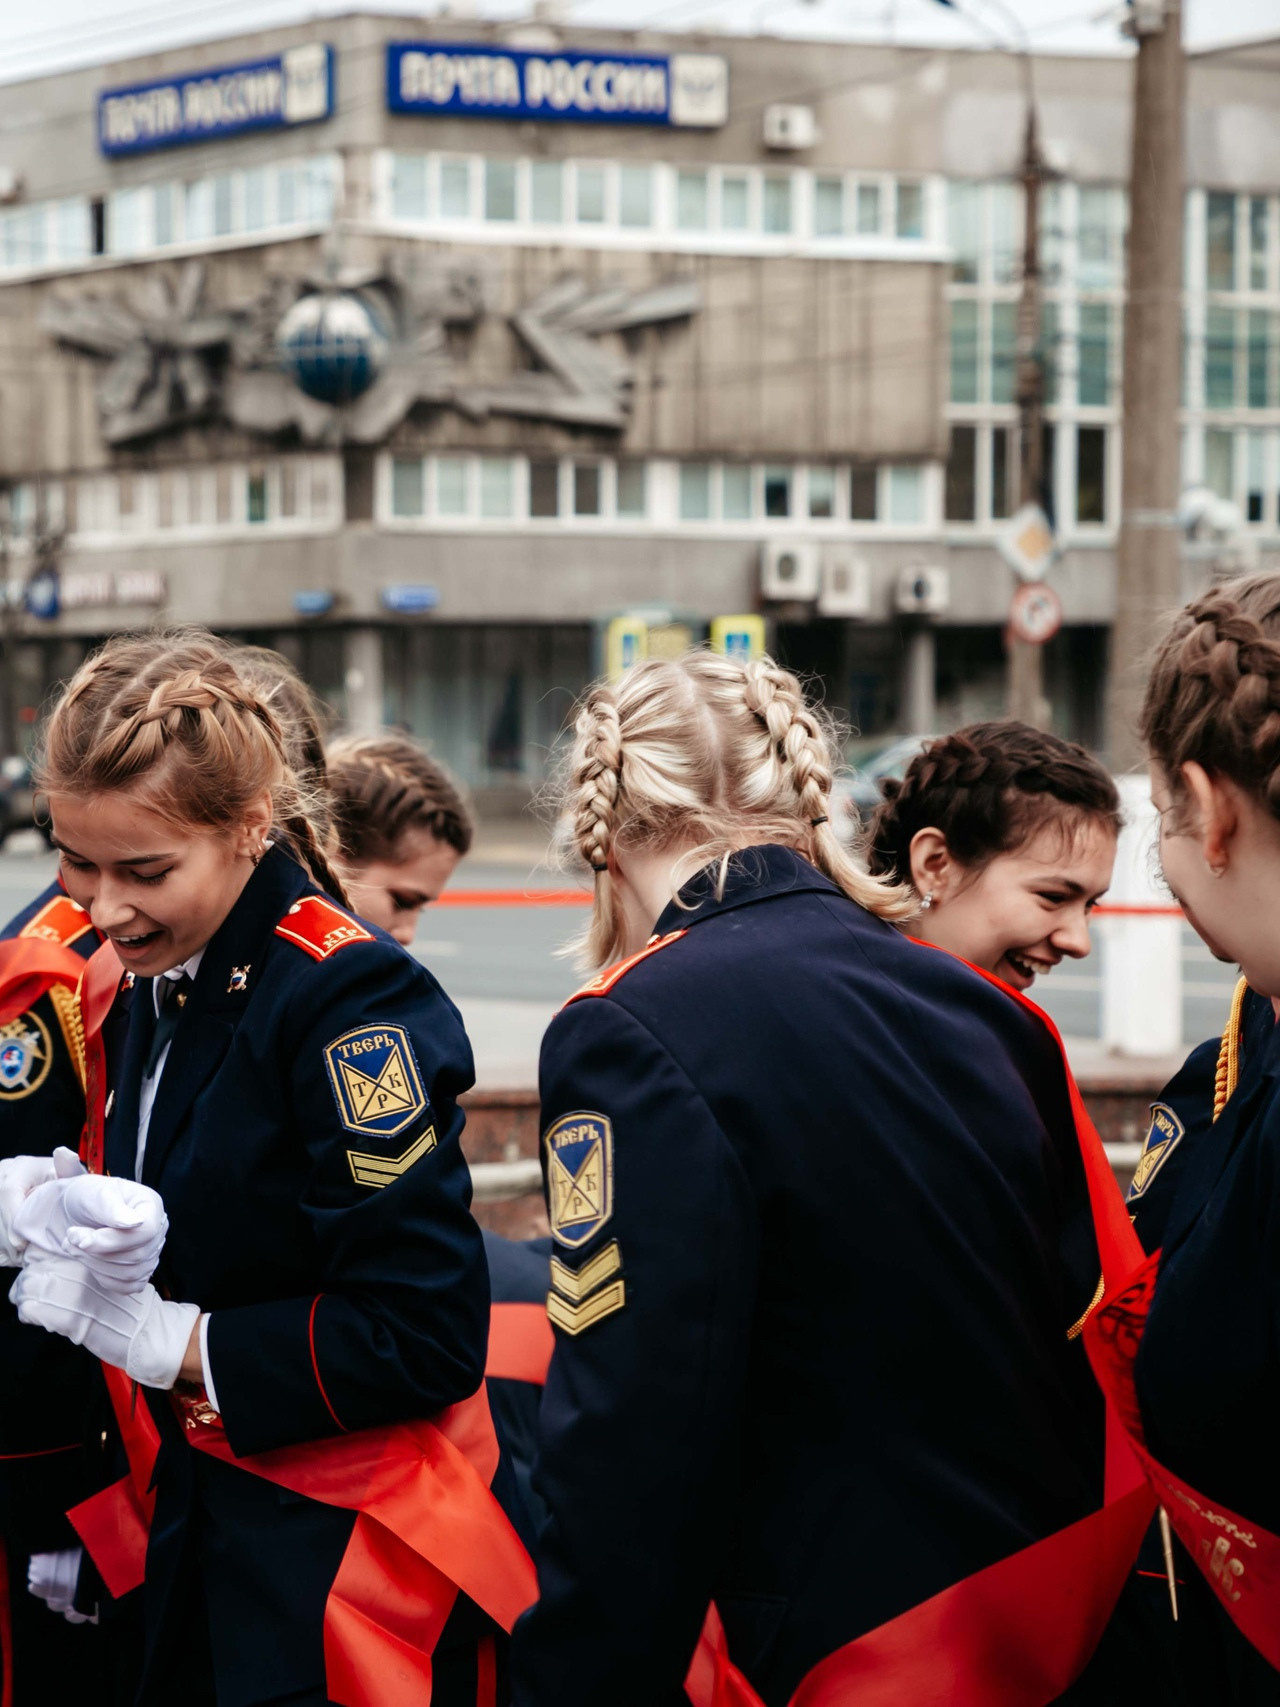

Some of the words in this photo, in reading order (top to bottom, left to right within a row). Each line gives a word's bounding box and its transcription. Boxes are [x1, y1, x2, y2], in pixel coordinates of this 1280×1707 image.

[399, 51, 520, 107] ПОЧТА
[524, 57, 668, 114] РОССИИ
[337, 1033, 396, 1059] ТВЕРЬ
[554, 1124, 599, 1149] ТВЕРЬ
